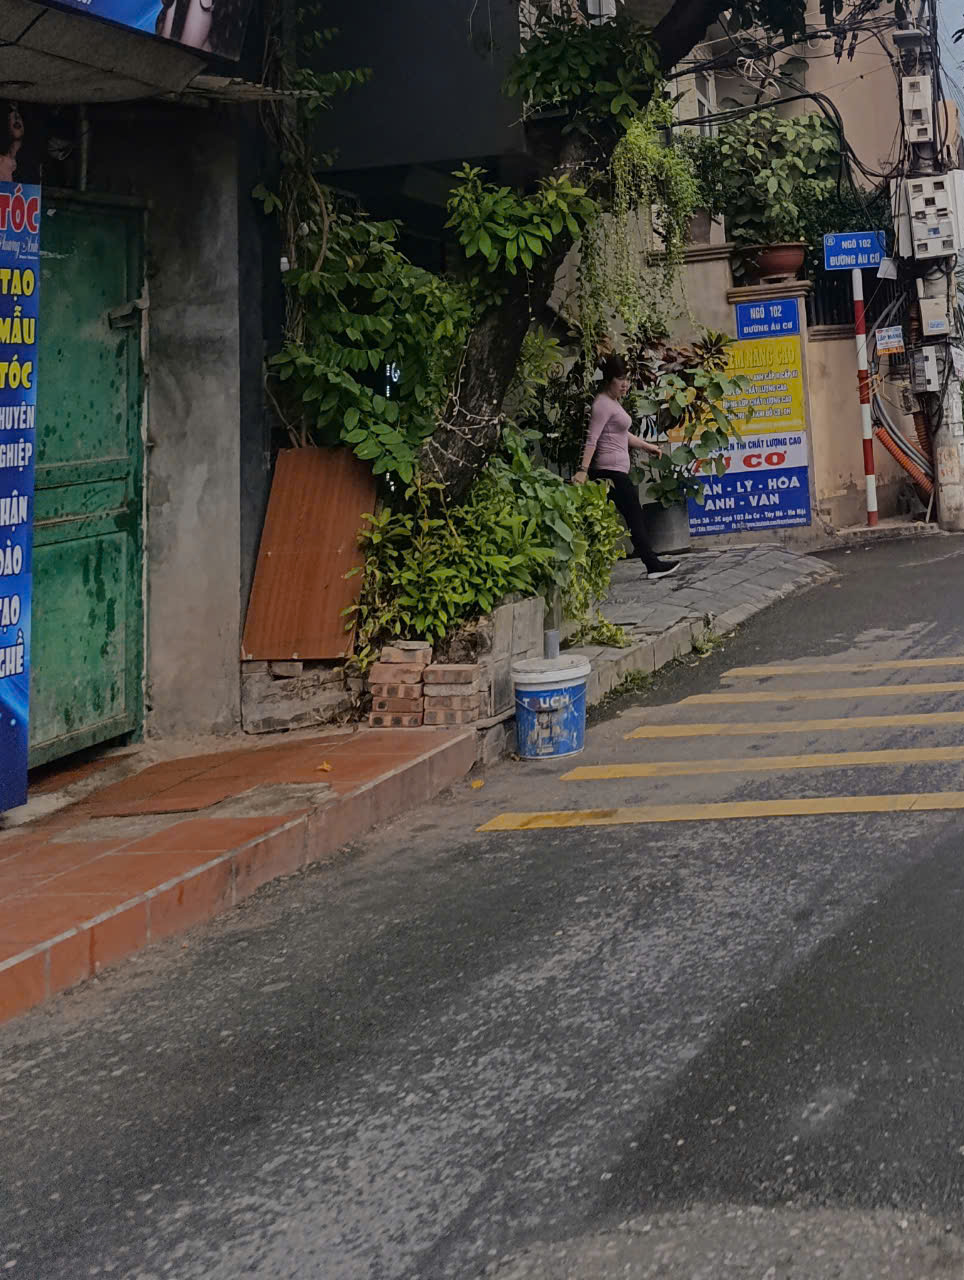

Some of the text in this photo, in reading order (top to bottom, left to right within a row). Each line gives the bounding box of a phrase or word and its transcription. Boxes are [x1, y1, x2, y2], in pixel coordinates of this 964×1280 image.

[0, 184, 40, 233] TÓC
[841, 238, 872, 249] NGÕ 102
[830, 251, 880, 266] ĐƯỜNG ÂU CƠ
[0, 268, 35, 301] TẠO
[750, 304, 782, 319] NGÕ 102
[0, 305, 35, 345] MẪU
[743, 323, 769, 333] ĐƯỜNG
[0, 354, 32, 389] TÓC
[748, 438, 765, 450] CHẤT
[766, 438, 787, 448] LƯỢNG
[788, 436, 802, 445] CAO
[743, 450, 788, 468] CƠ
[704, 497, 735, 511] ANH
